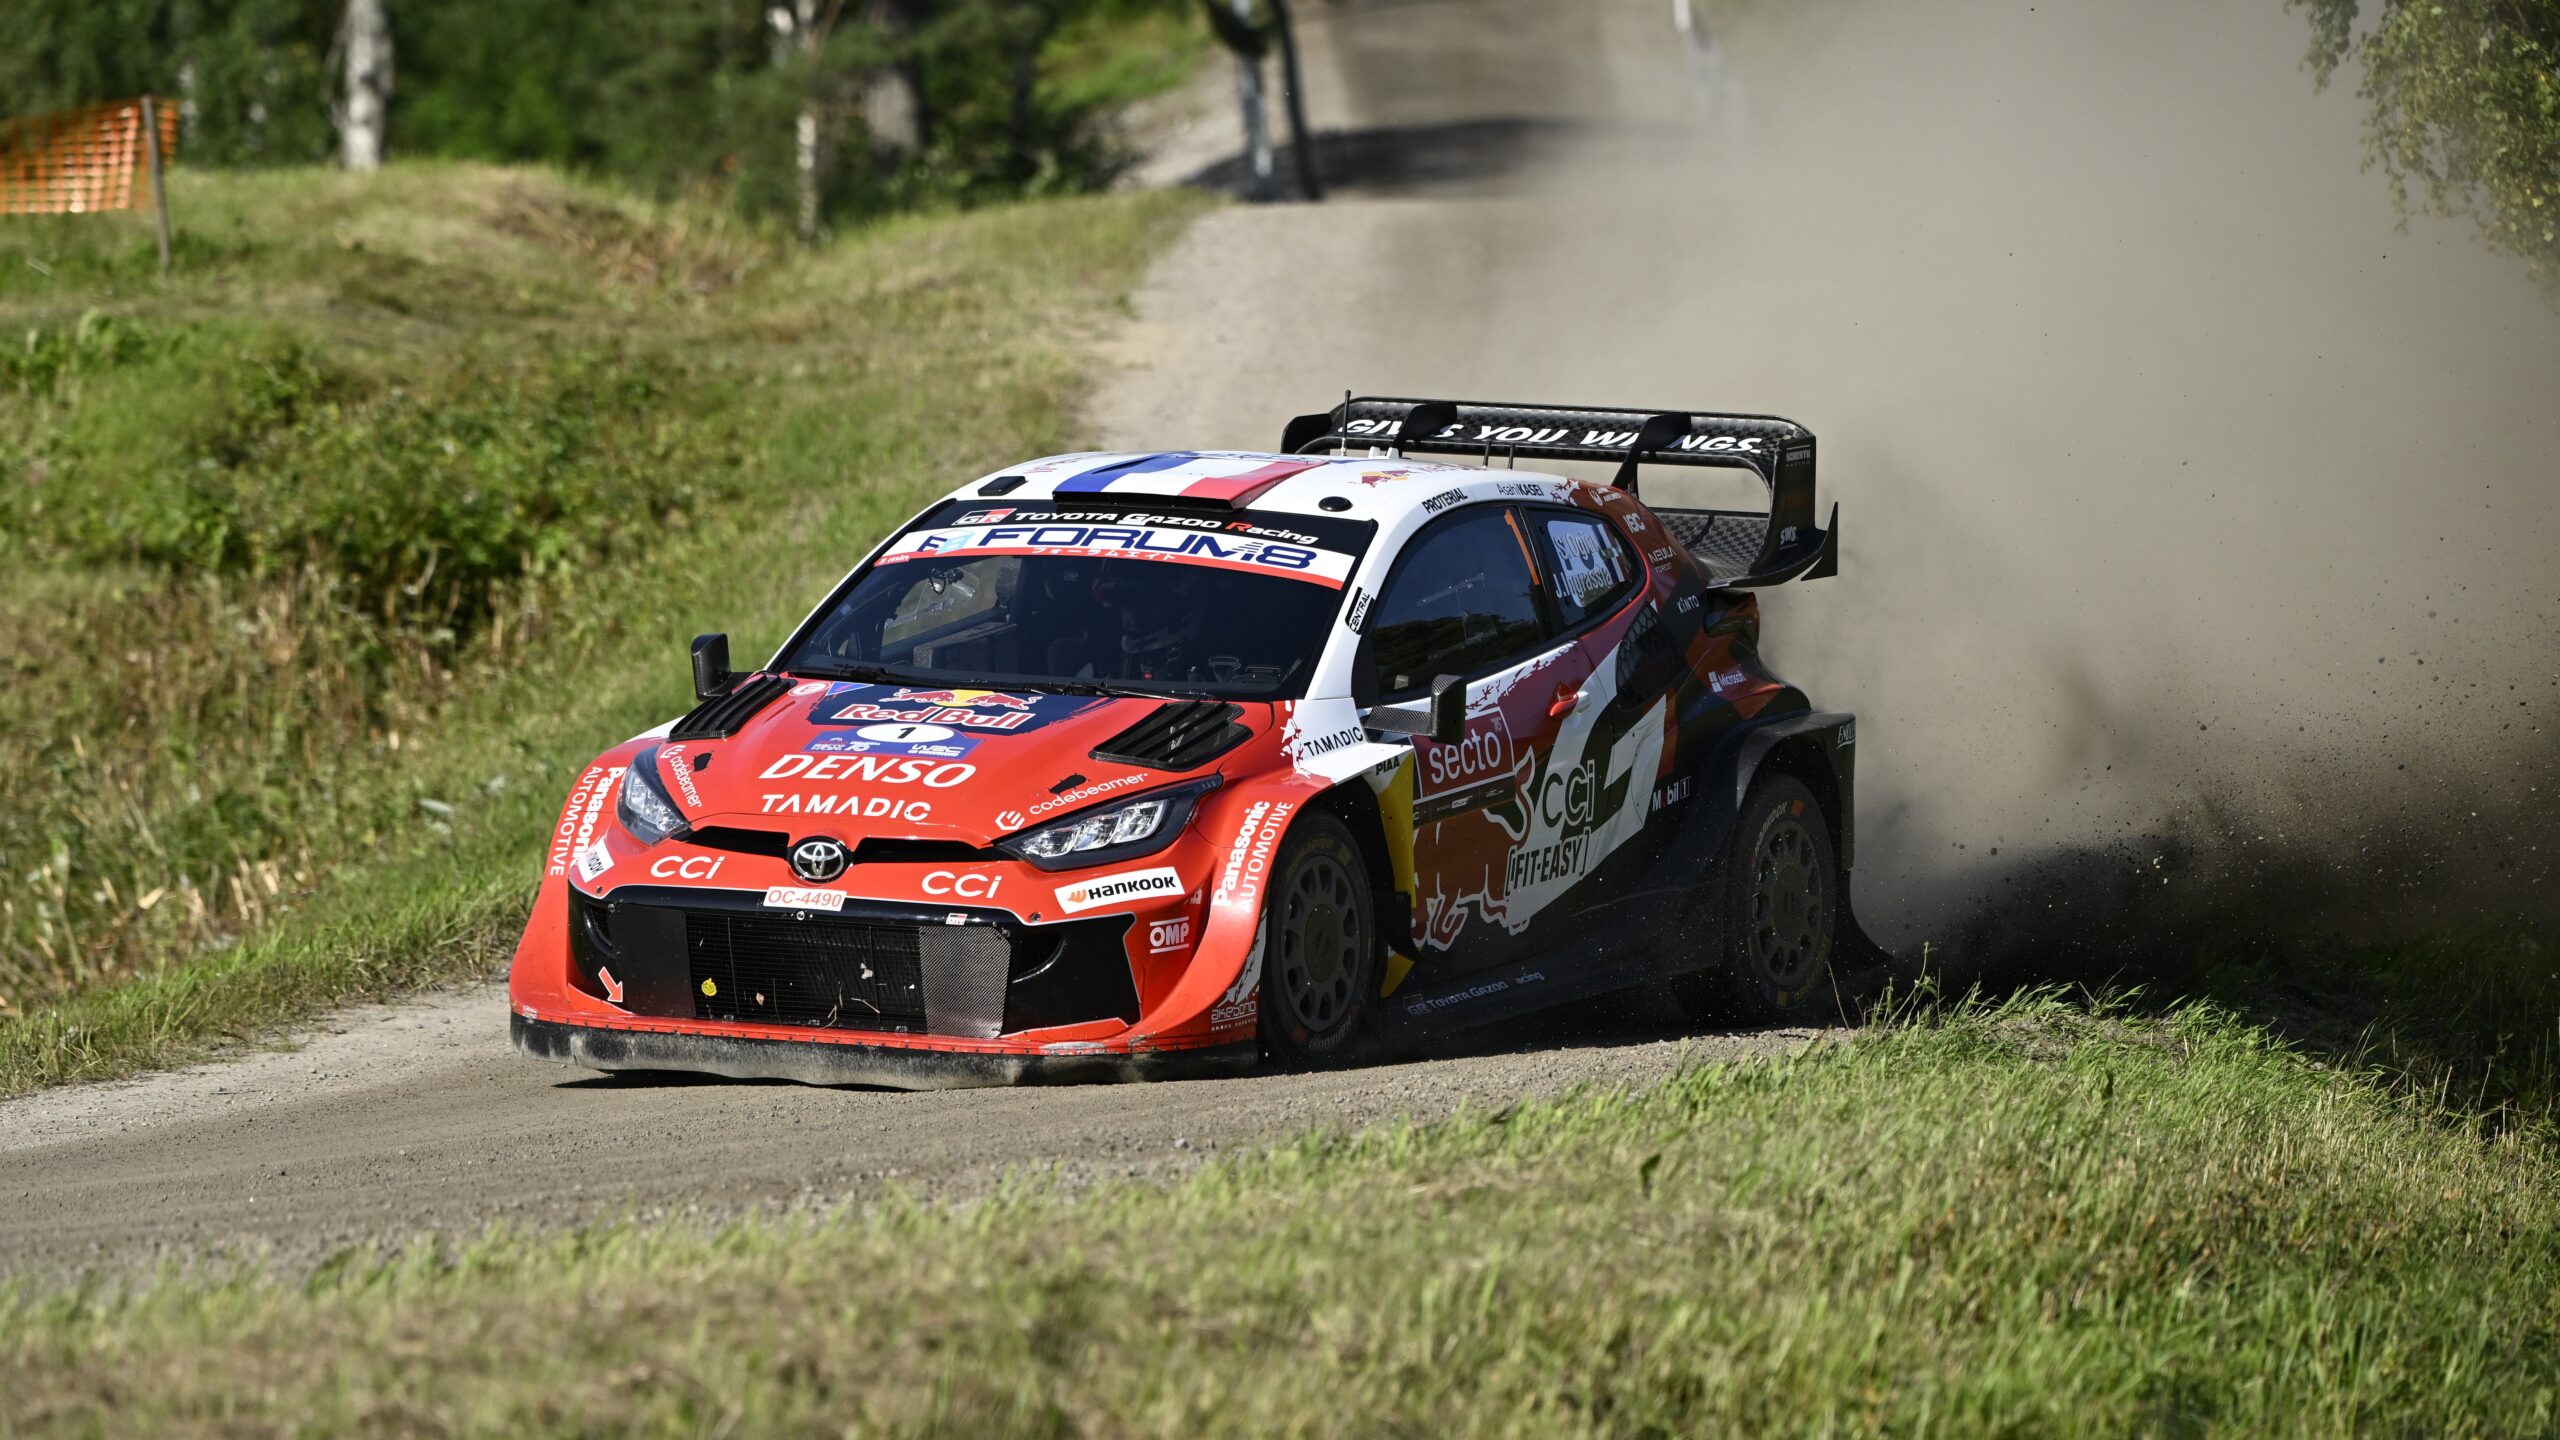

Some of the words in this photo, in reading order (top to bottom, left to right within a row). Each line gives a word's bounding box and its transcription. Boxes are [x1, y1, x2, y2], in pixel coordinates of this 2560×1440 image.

[1338, 418, 1464, 438] GIVS
[1473, 425, 1570, 443] YOU
[1421, 487, 1468, 514] PROTERIAL
[962, 513, 1004, 524] GR
[1015, 512, 1117, 522] TOYOTA
[1225, 521, 1319, 545] Racing
[977, 526, 1318, 570] FORUM8
[1349, 593, 1371, 633] CENTRAL
[830, 703, 938, 724] Red
[924, 707, 1037, 730] Bull
[897, 726, 917, 739] 1
[1303, 726, 1364, 758] TAMADIC
[1428, 728, 1502, 784] secto
[669, 754, 703, 808] codebeamer
[758, 753, 978, 788] DENSO
[1375, 755, 1401, 777] PIAA
[760, 793, 932, 822] TAMADIC
[1029, 772, 1149, 816] codebeamer
[550, 766, 604, 876] AUTOMOTIVE
[1213, 800, 1271, 907] Panasonic
[1237, 800, 1294, 913] AUTOMOTIVE
[767, 887, 843, 908] OC-4490
[1149, 920, 1190, 946] OMP
[1211, 1000, 1257, 1021] akebono
